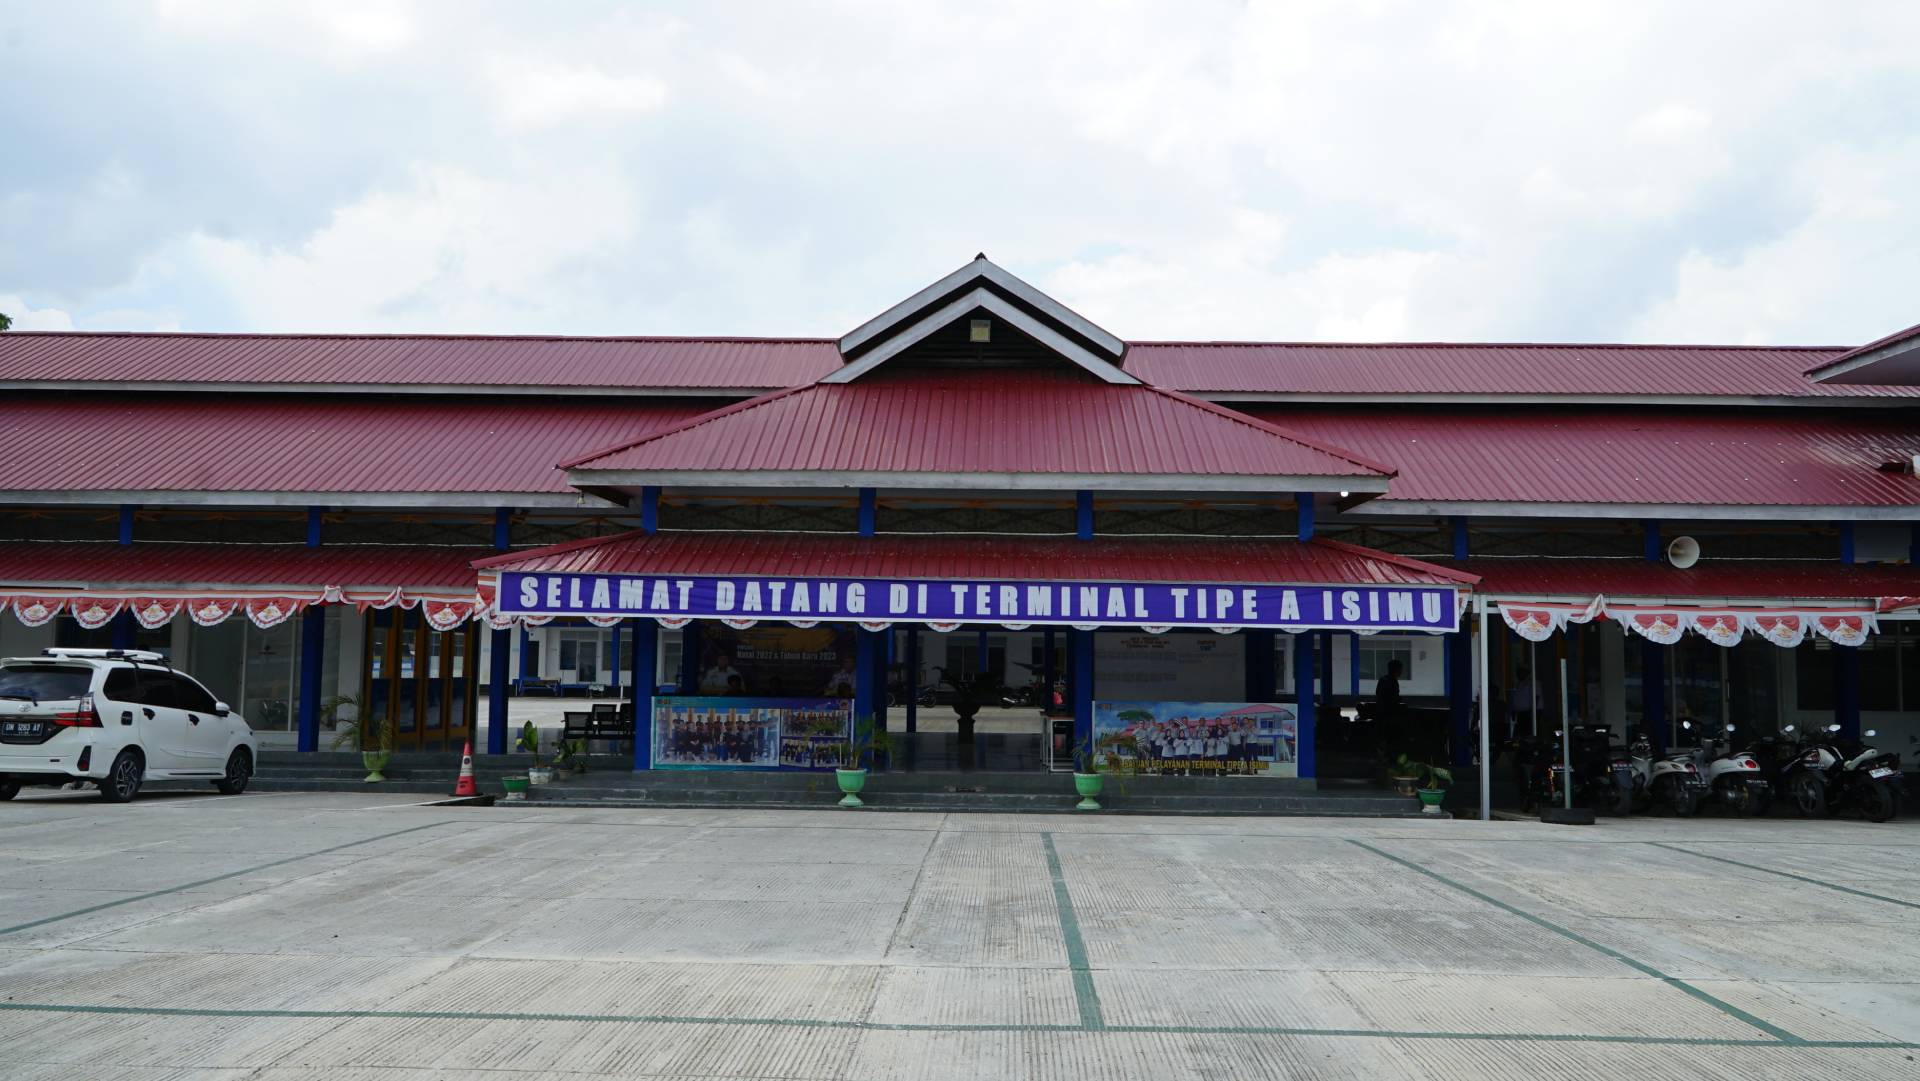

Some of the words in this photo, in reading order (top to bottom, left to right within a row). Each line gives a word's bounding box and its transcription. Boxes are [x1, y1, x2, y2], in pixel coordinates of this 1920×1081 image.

[520, 576, 695, 611] SELAMAT
[716, 581, 866, 615] DATANG
[889, 583, 929, 615] DI
[950, 584, 1150, 619] TERMINAL
[1170, 588, 1258, 620] TIPE
[1280, 590, 1301, 621] A
[1322, 591, 1442, 624] ISIMU
[1151, 759, 1190, 769] PELAYANAN
[1191, 760, 1225, 769] TERMINAL
[1226, 760, 1242, 769] TIPE
